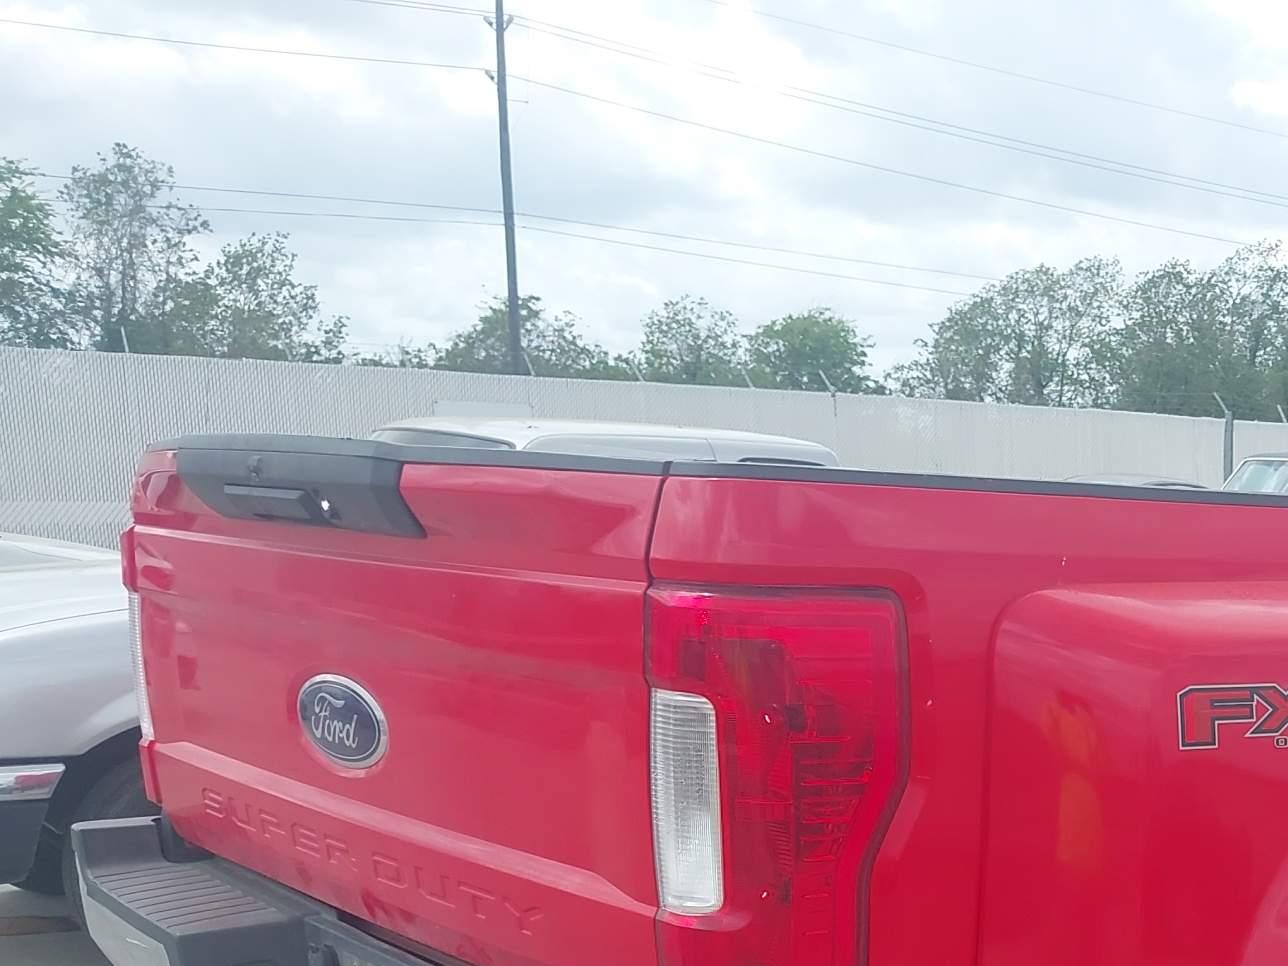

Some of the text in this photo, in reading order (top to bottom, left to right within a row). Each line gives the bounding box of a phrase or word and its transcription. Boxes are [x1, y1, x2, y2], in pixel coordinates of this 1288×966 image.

[311, 692, 359, 749] Ford
[201, 786, 545, 936] SUPER DUTY
